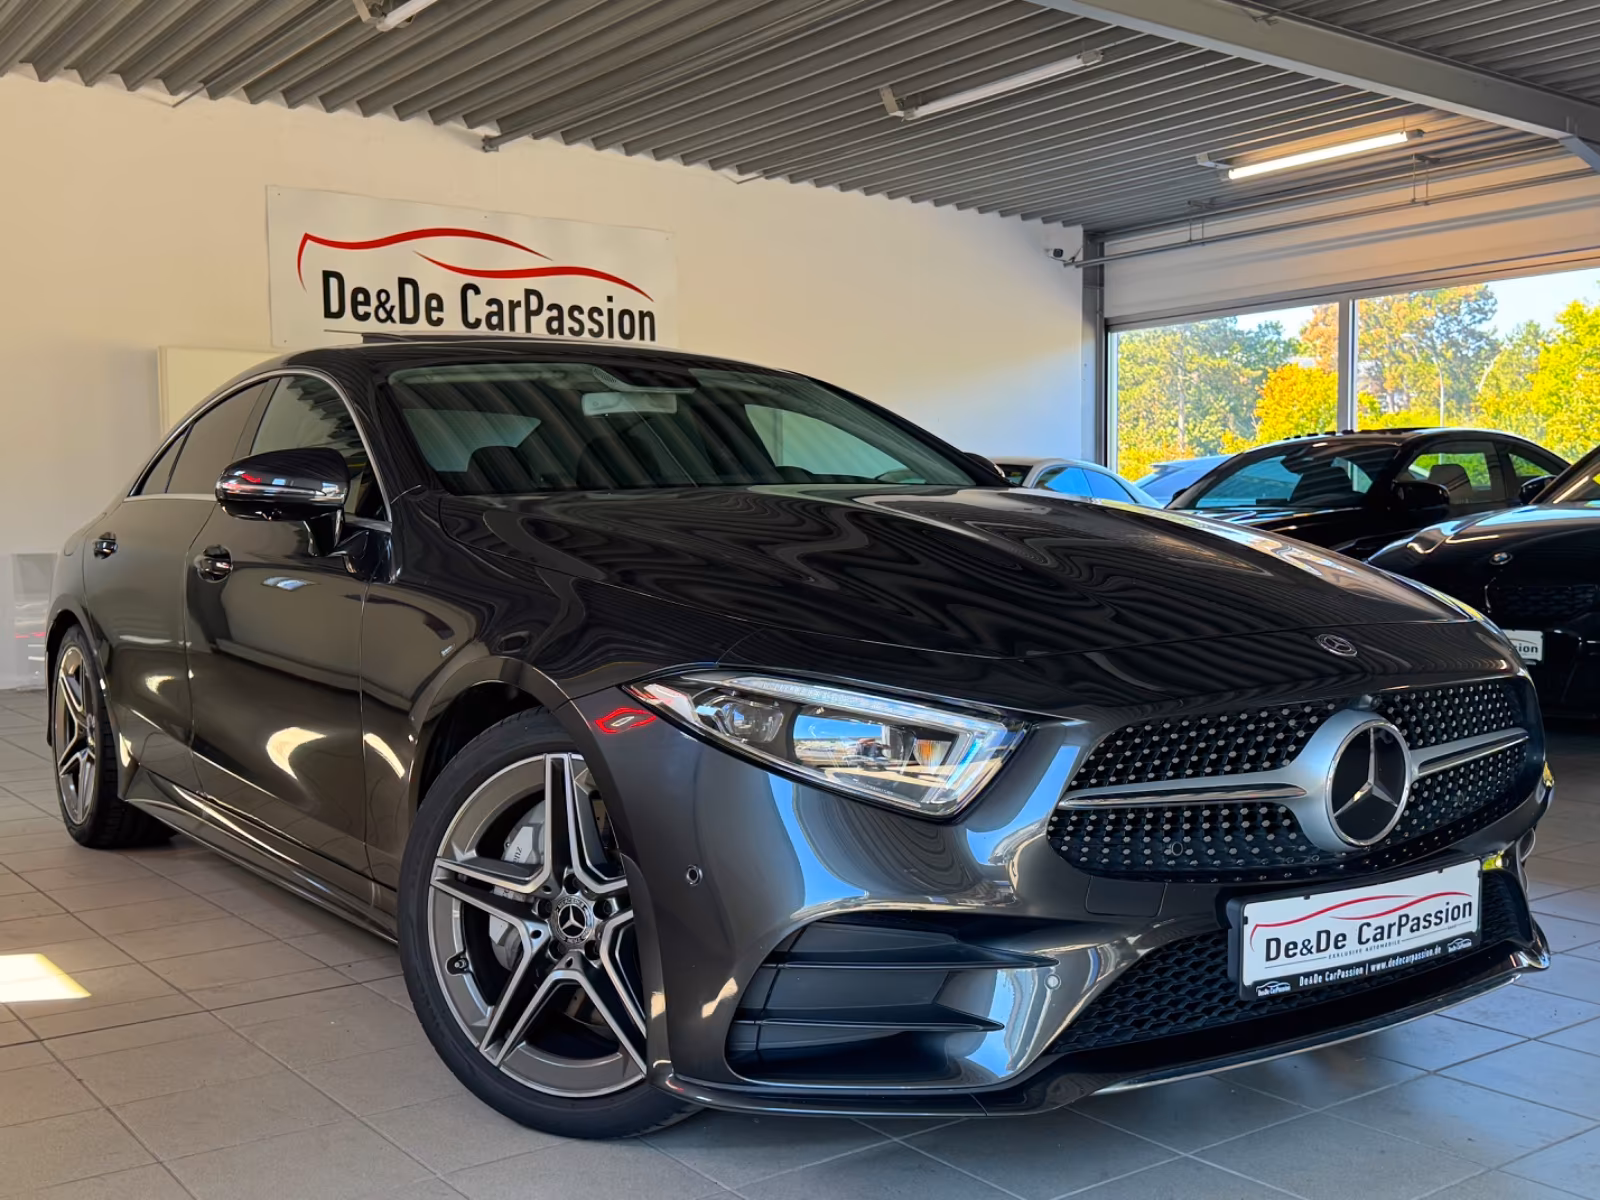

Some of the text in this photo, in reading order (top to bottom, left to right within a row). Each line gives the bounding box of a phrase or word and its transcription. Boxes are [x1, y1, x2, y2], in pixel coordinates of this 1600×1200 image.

[322, 269, 656, 342] De&De CarPassion
[1265, 901, 1472, 962] De&De CarPassion
[1325, 966, 1364, 982] CarPassion
[1370, 944, 1442, 972] www.dedecarpassion.de
